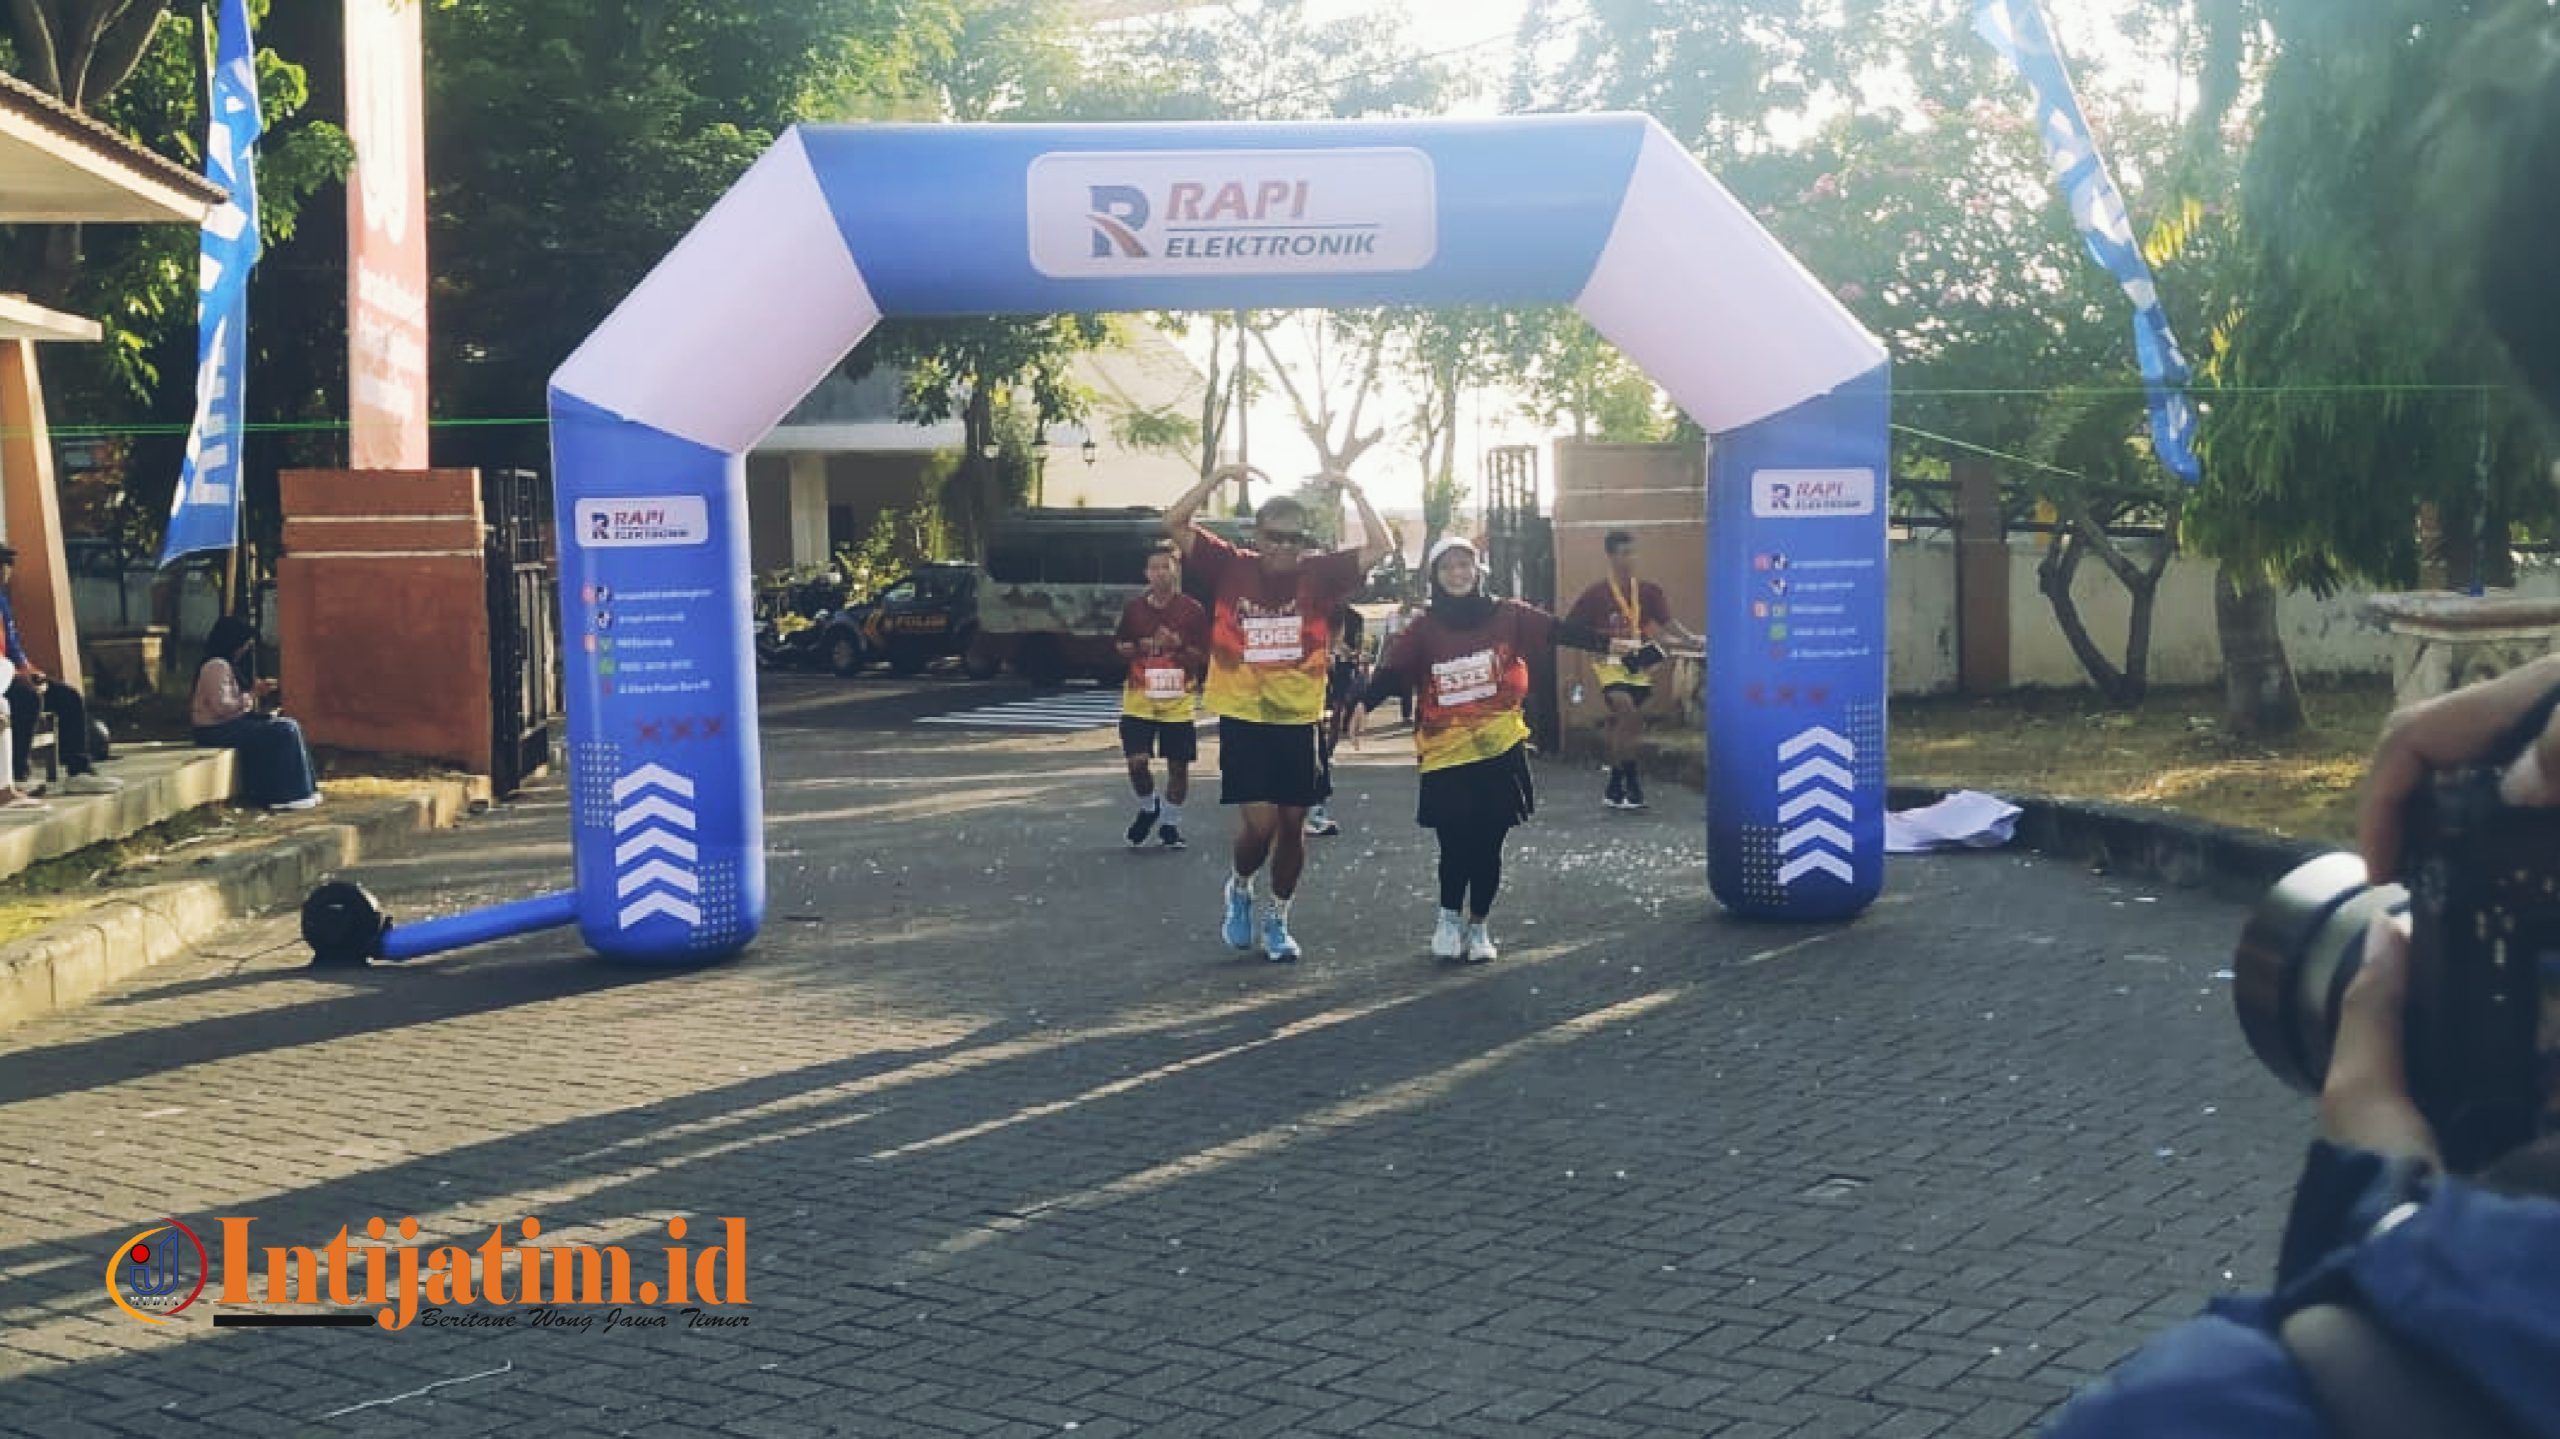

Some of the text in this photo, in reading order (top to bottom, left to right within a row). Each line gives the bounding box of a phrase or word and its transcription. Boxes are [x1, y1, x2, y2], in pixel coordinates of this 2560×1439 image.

[1165, 180, 1309, 221] RAPI
[1165, 233, 1376, 258] ELEKTRONIK
[614, 510, 664, 525] RAPI
